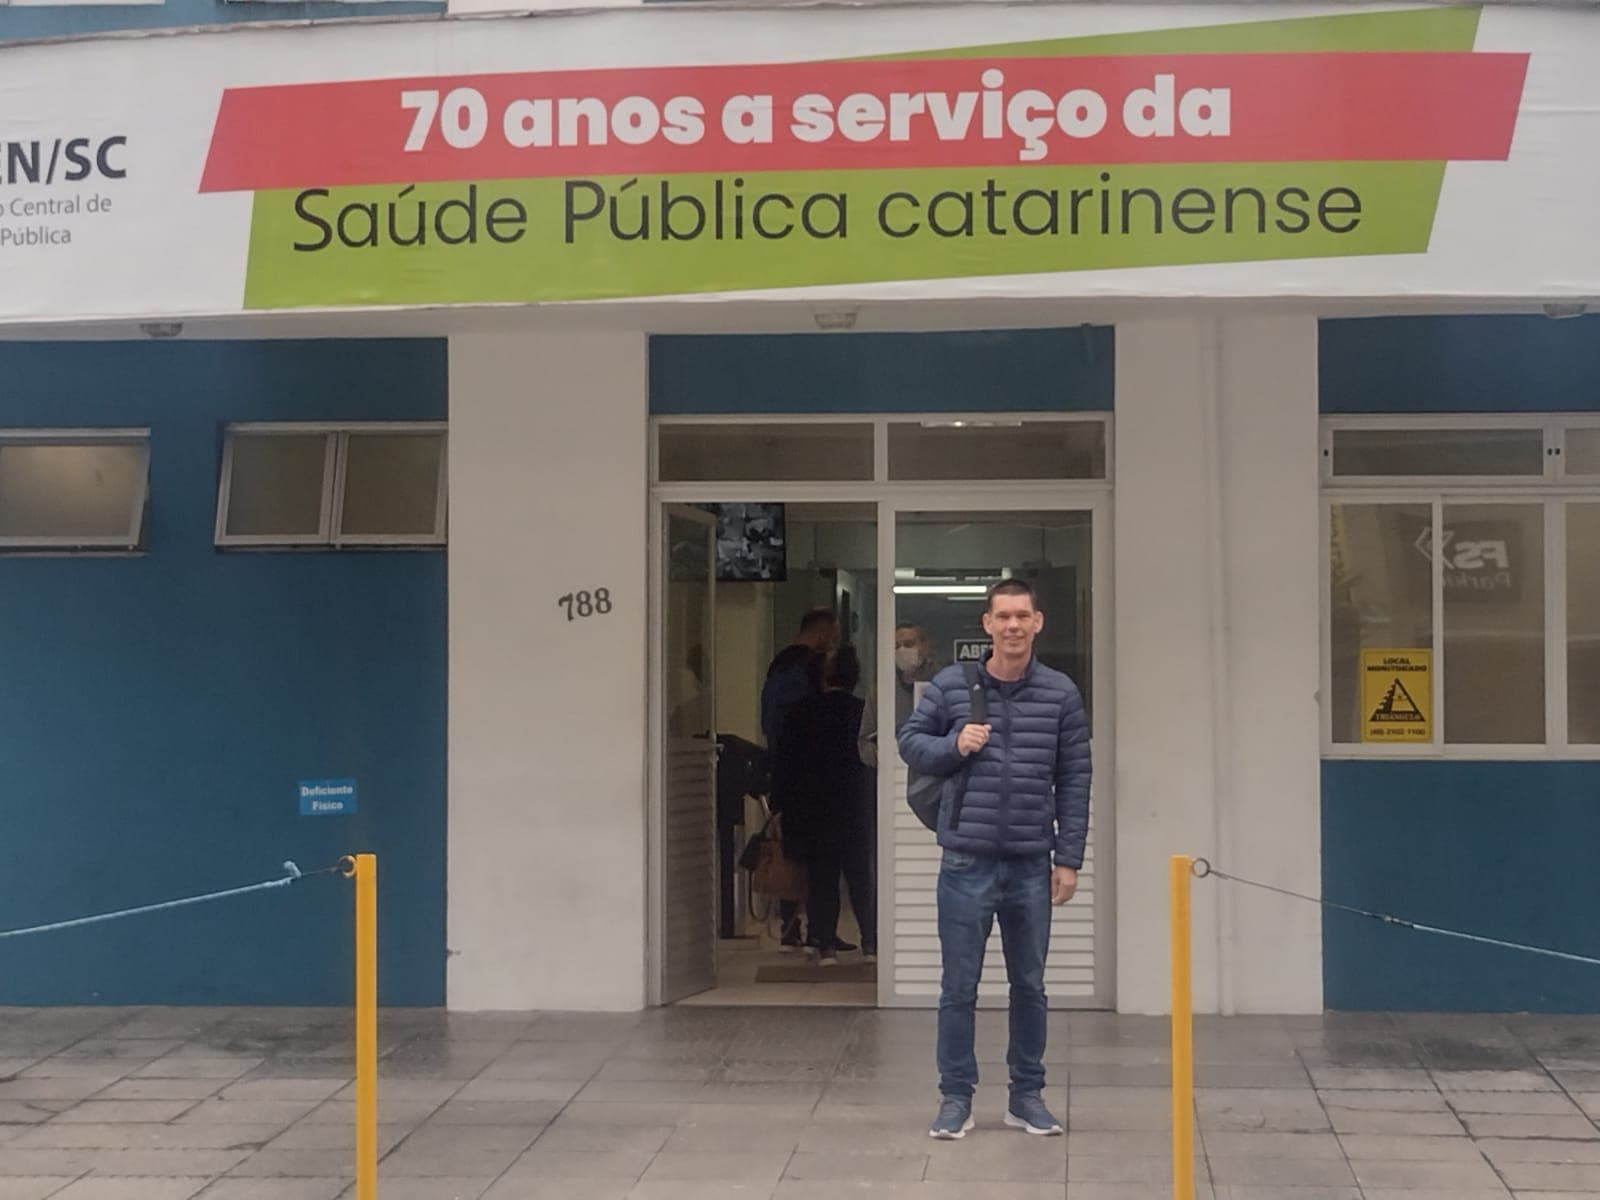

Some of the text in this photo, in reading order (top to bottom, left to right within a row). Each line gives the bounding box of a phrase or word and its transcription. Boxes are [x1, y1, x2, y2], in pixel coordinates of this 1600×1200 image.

[400, 68, 1231, 161] 70 anos a serviço da
[0, 135, 127, 185] N/SC
[9, 194, 80, 217] Central
[86, 193, 112, 213] de
[293, 172, 1362, 252] Saúde Pública catarinense
[0, 225, 71, 246] Pública
[558, 587, 612, 621] 788
[301, 785, 353, 796] Deficiente
